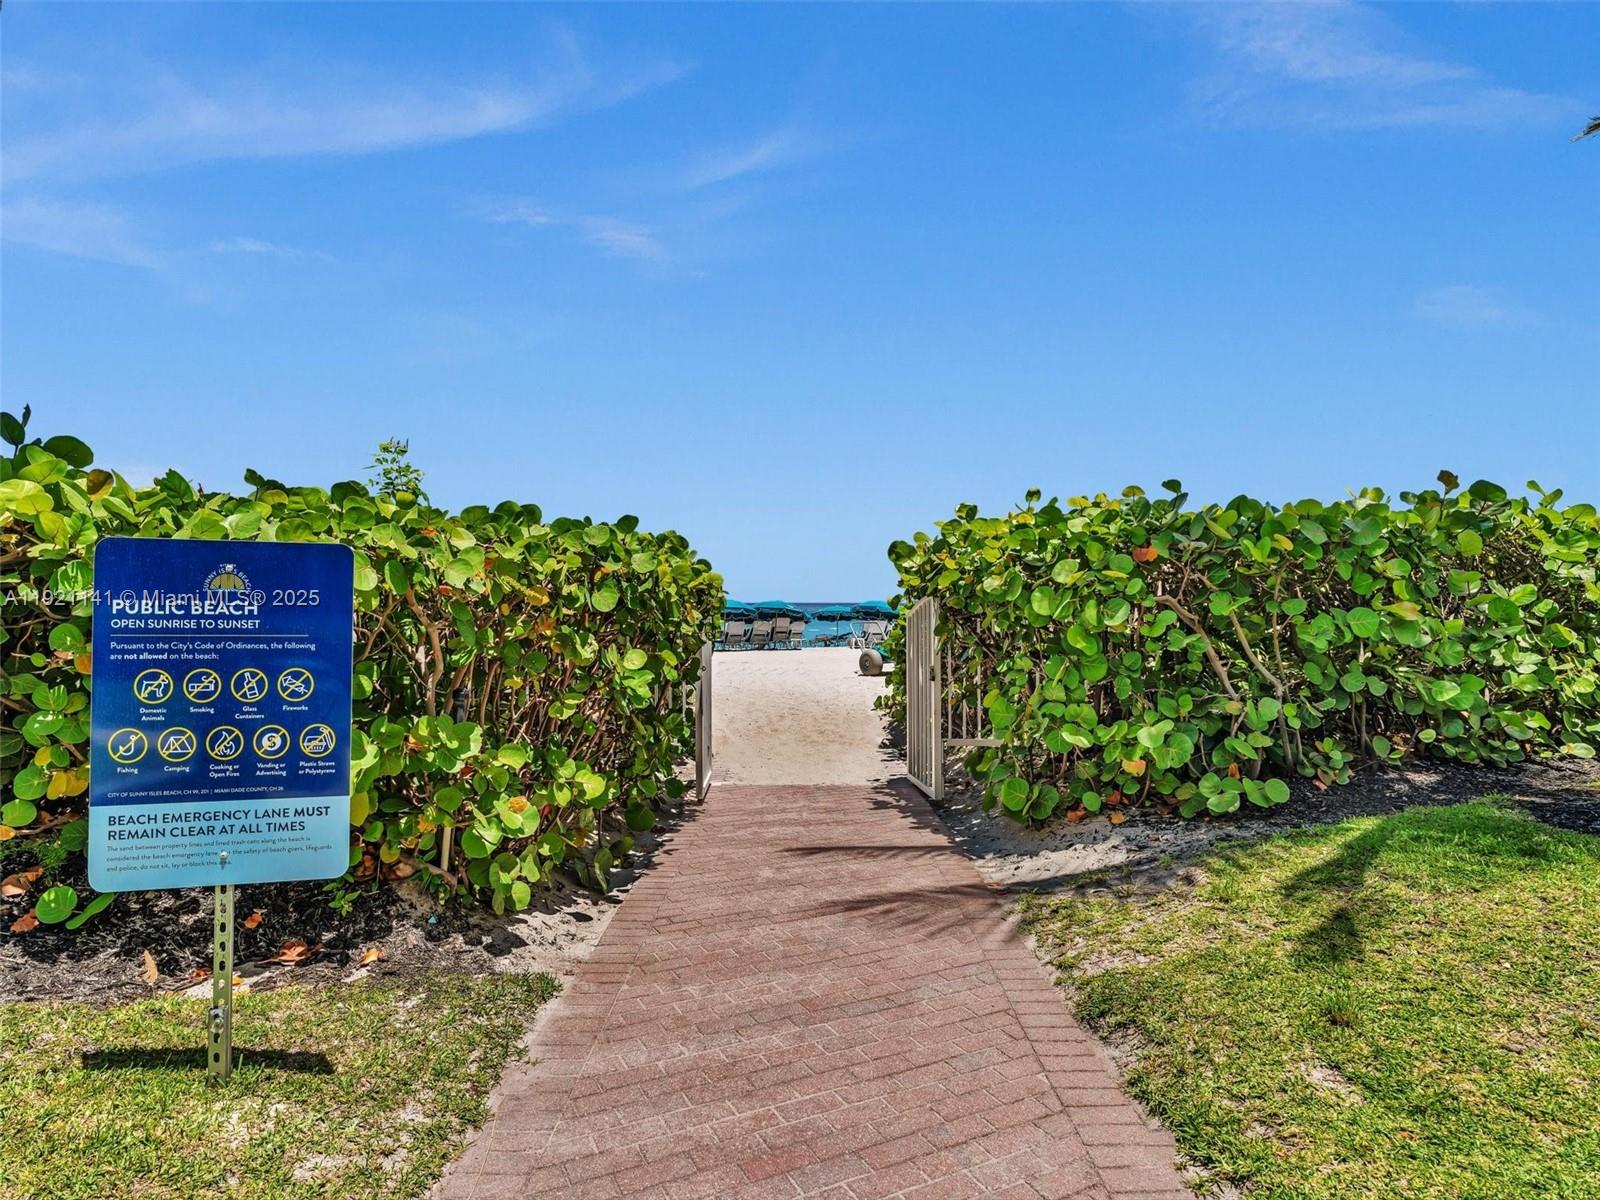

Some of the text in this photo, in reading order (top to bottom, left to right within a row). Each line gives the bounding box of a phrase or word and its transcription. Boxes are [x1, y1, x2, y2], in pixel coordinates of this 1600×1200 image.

[112, 600, 258, 615] PUBLIC BEACH
[111, 620, 260, 629] OPEN SUNRISE TO SUNSET
[171, 642, 192, 650] City's
[284, 642, 316, 651] following
[109, 806, 330, 826] BEACH EMERGENCY LANE MUST
[108, 821, 305, 840] REMAIN CLEAR AT ALL TIMES
